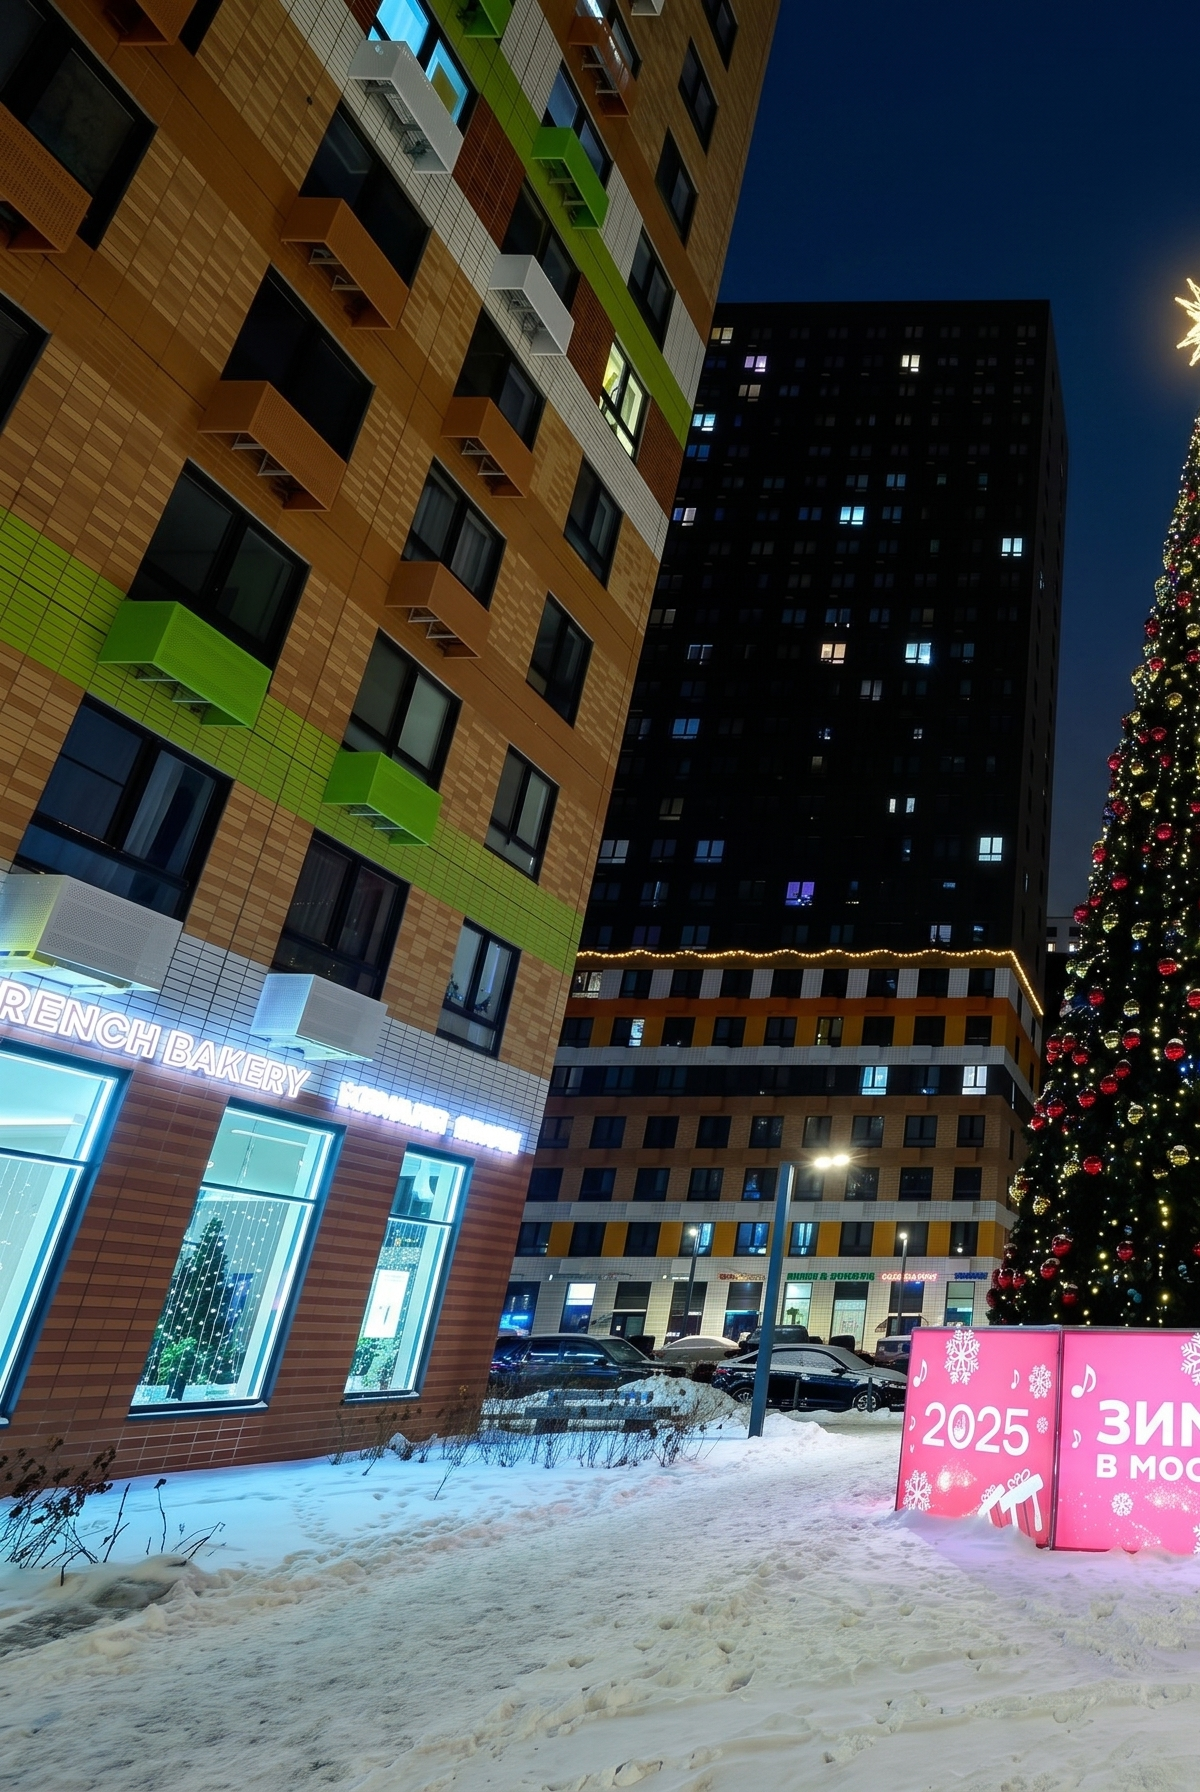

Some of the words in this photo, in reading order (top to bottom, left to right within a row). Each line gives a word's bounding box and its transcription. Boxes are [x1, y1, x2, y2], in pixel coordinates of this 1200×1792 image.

[0, 979, 163, 1060] RENCH
[162, 1029, 312, 1099] BAKERY
[921, 1401, 1030, 1456] 2025
[1096, 1453, 1118, 1478] В
